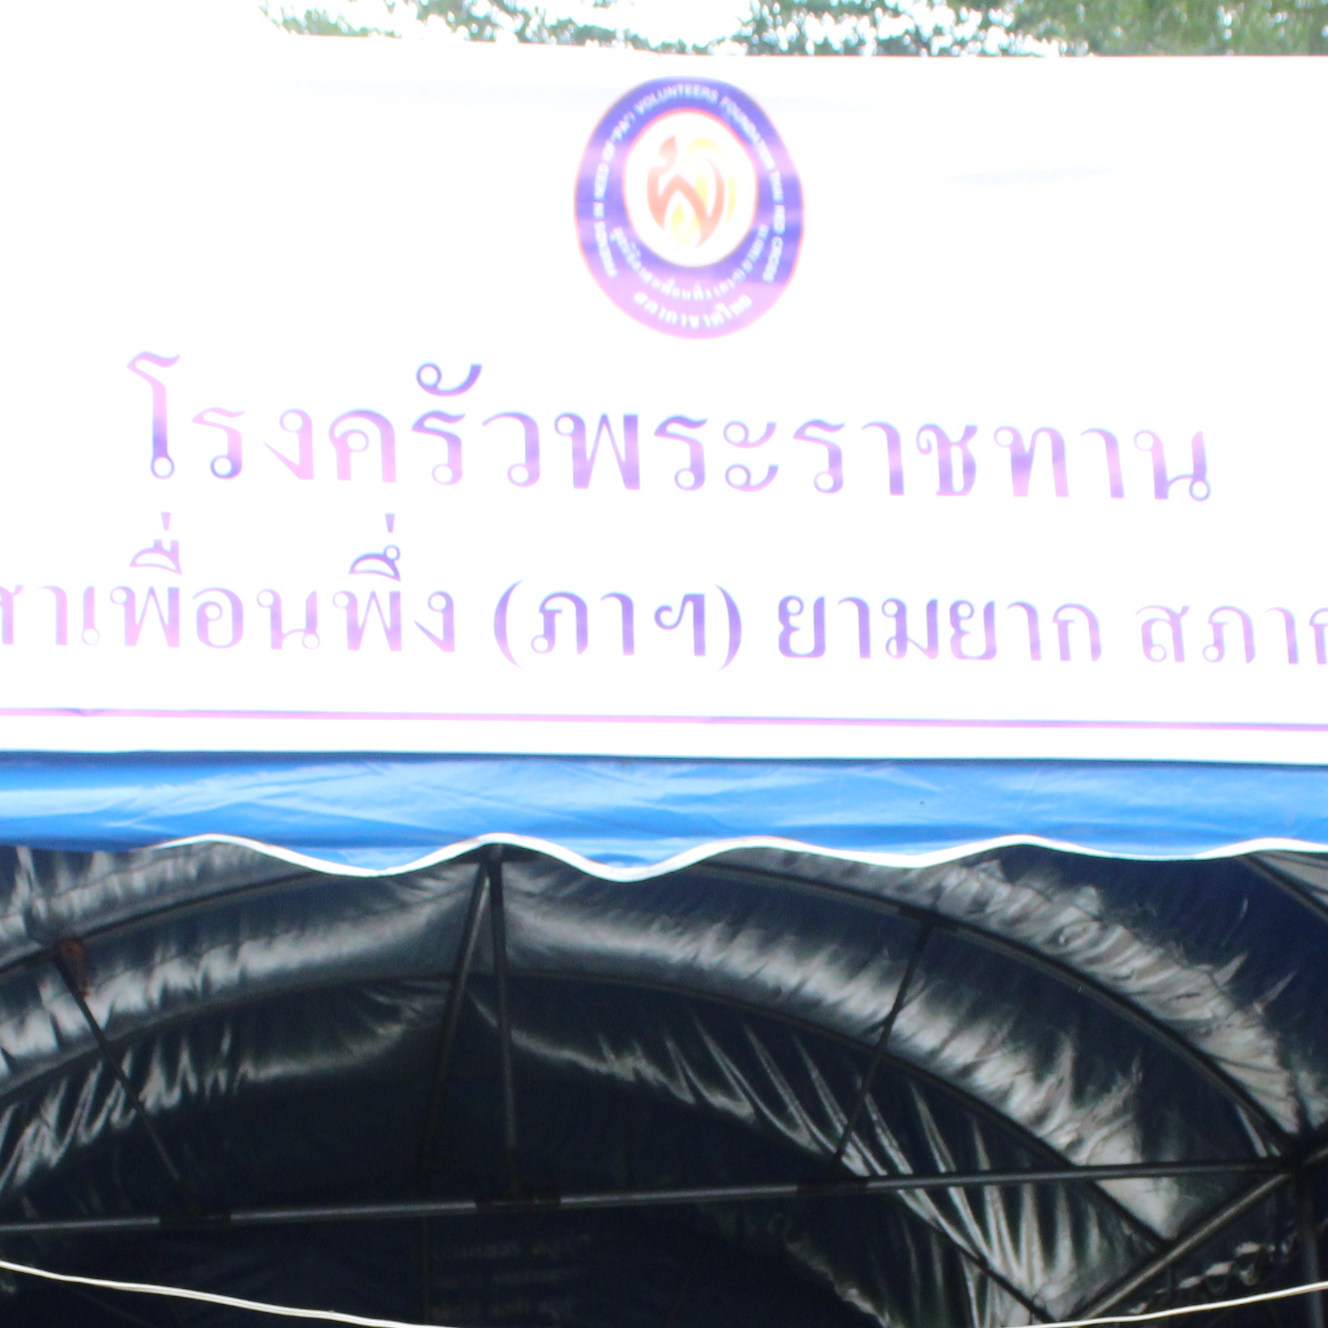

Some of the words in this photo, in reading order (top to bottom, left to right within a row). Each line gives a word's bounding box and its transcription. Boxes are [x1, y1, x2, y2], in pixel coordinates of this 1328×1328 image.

[125, 350, 1212, 503] โรงครัวพระราชทาน
[492, 579, 743, 671] (ภาฯ)
[776, 594, 1103, 662] ยามยาก
